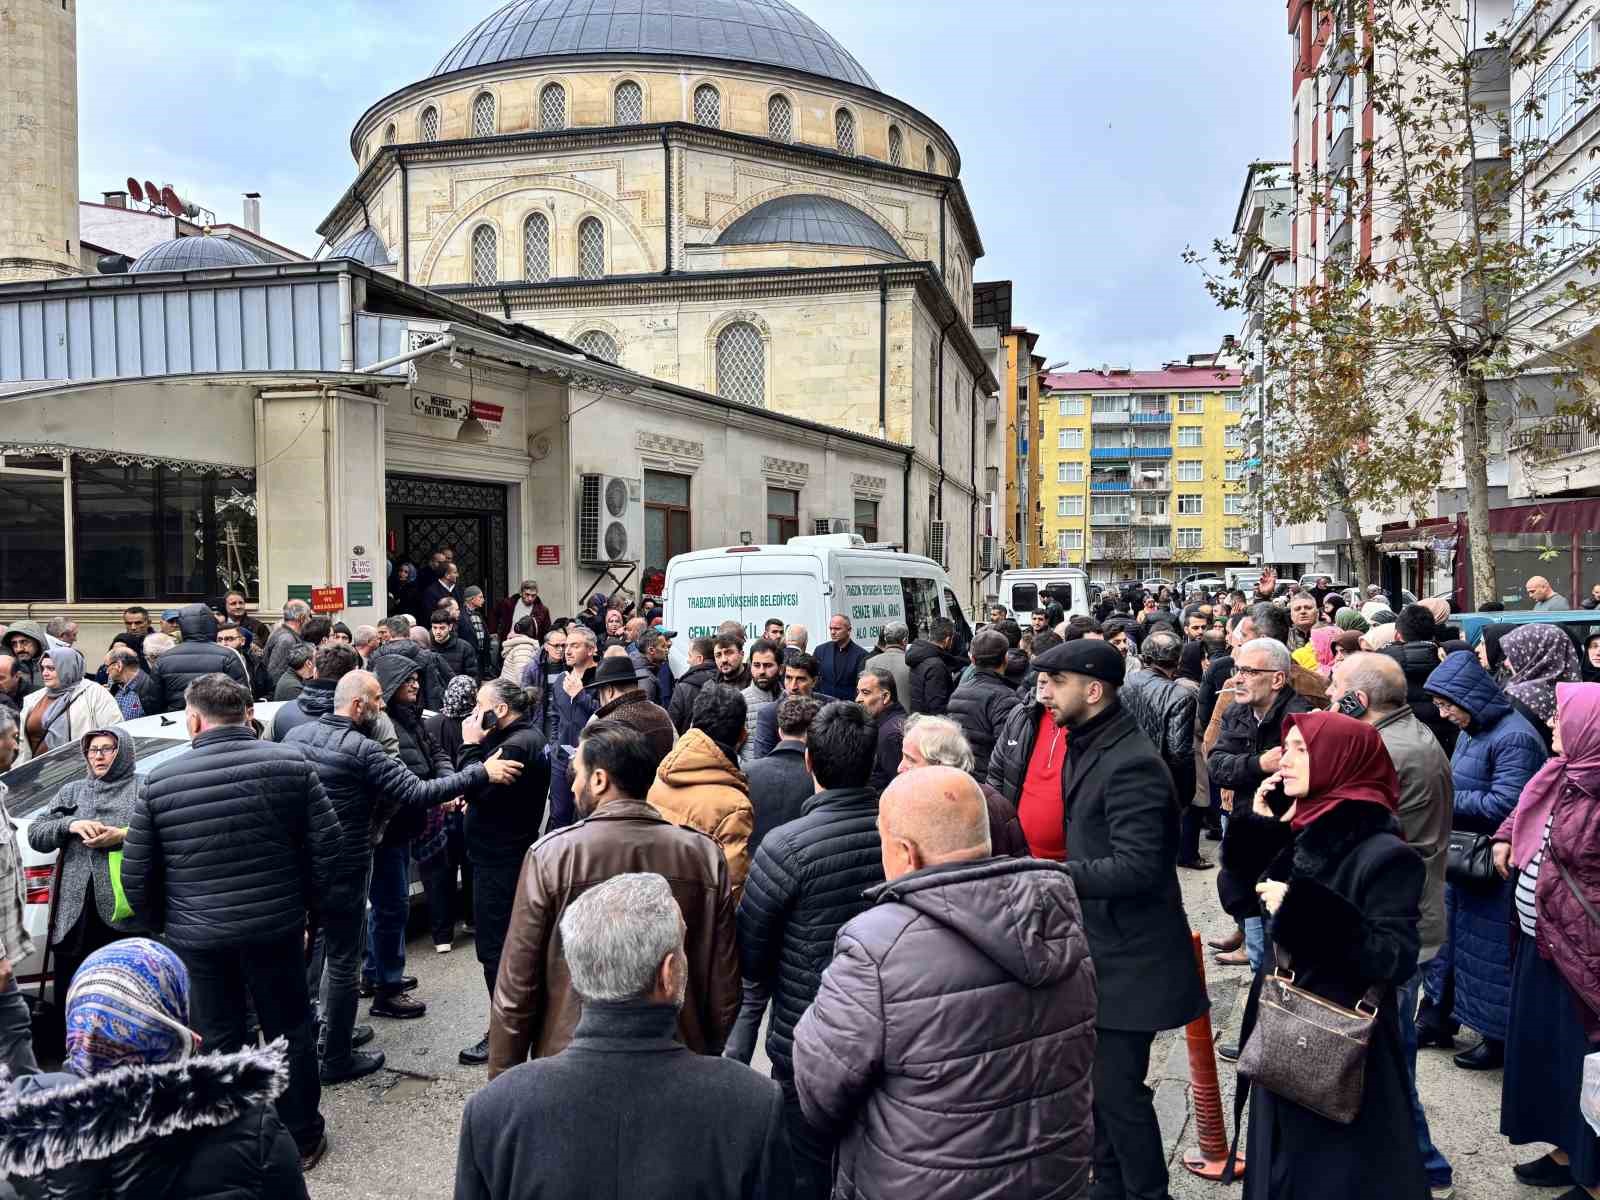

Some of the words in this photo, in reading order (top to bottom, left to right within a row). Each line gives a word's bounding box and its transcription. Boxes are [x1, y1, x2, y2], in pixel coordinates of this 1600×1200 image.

[430, 394, 452, 409] MERKEZ
[688, 596, 716, 609] TRABZON
[717, 593, 759, 608] BÜYÜKŞEHİR
[760, 591, 799, 607] BELEDİYESİ
[852, 604, 871, 619] CENAZE
[856, 626, 867, 640] ALO
